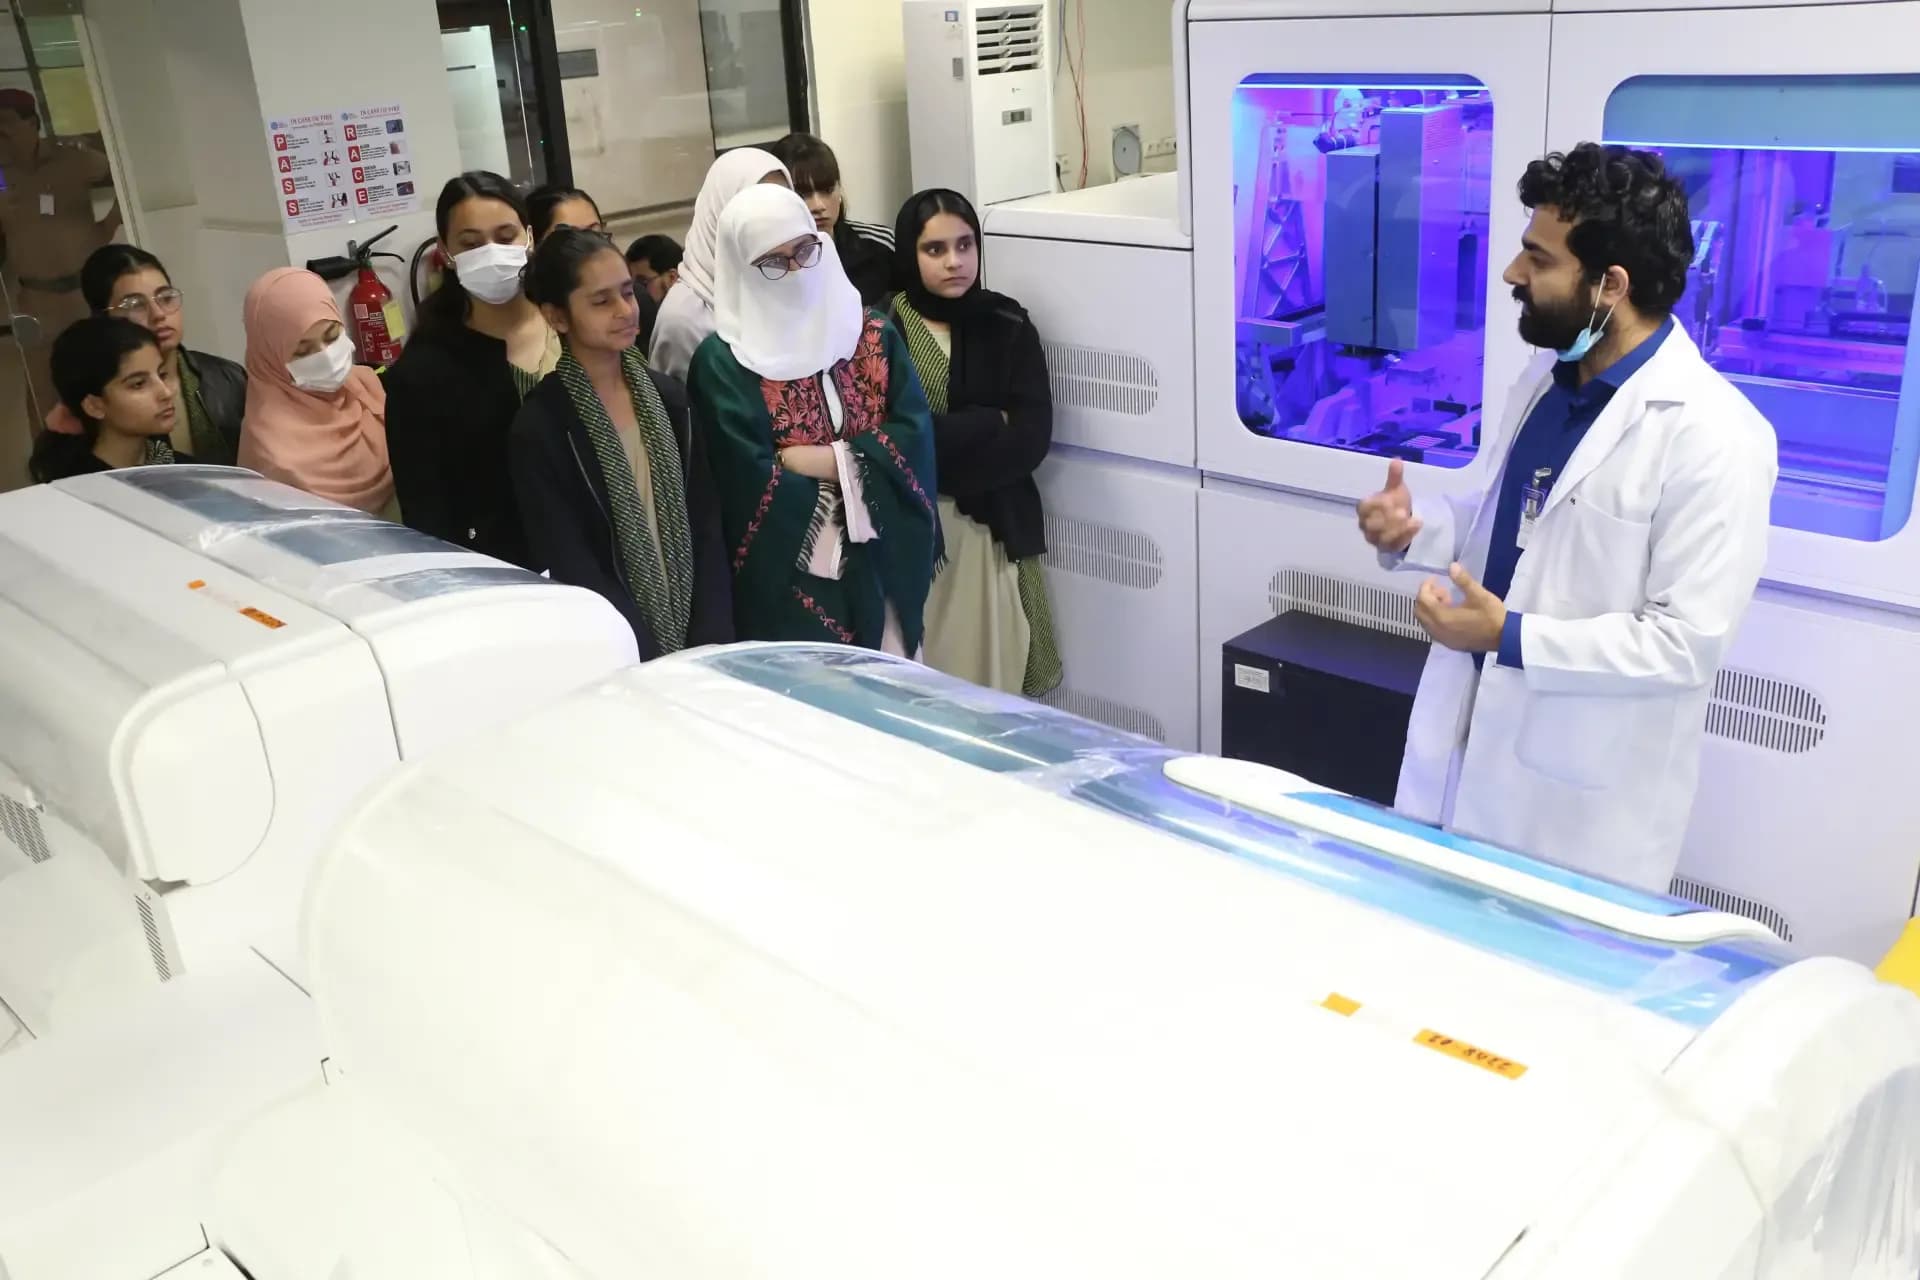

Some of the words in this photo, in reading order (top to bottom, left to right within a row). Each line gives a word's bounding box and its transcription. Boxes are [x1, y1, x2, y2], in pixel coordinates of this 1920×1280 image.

[346, 127, 356, 138] R
[276, 137, 284, 148] P
[350, 149, 360, 160] A
[280, 159, 290, 170] A
[354, 170, 363, 180] C
[284, 180, 292, 191] S
[358, 190, 367, 201] E
[288, 202, 297, 213] S
